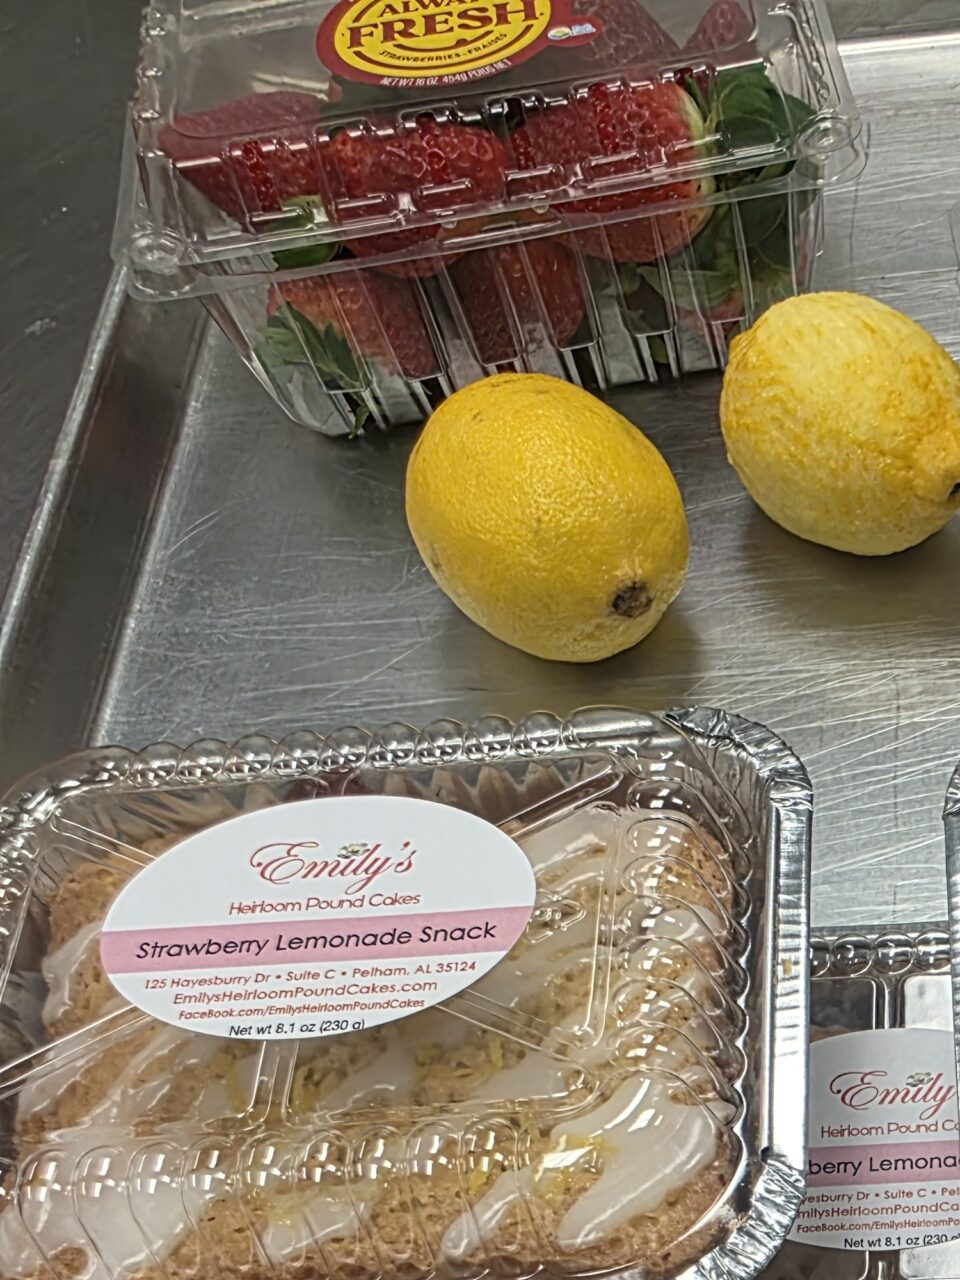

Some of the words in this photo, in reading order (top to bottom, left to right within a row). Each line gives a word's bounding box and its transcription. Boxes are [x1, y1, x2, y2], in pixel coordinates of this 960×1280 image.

[347, 0, 540, 50] FRESH
[379, 49, 462, 63] STRAWBERRIES
[467, 33, 508, 55] FRAISES
[249, 840, 420, 895] Emily's
[229, 900, 301, 915] Heirloom
[306, 895, 364, 911] Pound
[369, 892, 421, 907] Cakes
[136, 938, 269, 960] Strawberry
[276, 928, 412, 951] Lemonade
[419, 921, 497, 943] Snack
[144, 979, 167, 990] 125
[171, 975, 250, 989] Hayesburry
[255, 973, 271, 983] Dr
[286, 970, 320, 981] Suite
[324, 970, 336, 980] C
[352, 965, 410, 978] Pelham,
[414, 964, 431, 975] AL
[436, 961, 477, 974] 35124
[173, 980, 437, 1005] EmilysHeirloomPoundCakes.com
[179, 998, 424, 1021] FaceBook.com/EmilysHeirloomPoundCakes
[229, 1025, 252, 1036] Net
[256, 1024, 272, 1036] wt
[275, 1022, 295, 1034] 8.1
[300, 1023, 316, 1033] oz
[319, 1020, 349, 1034] (230
[830, 1070, 957, 1120] Emily
[821, 1123, 884, 1139] Heirloom
[888, 1120, 938, 1135] Pound
[808, 1159, 862, 1176] berry
[870, 1155, 960, 1172] Lemona
[857, 1191, 870, 1200] Dr
[884, 1189, 913, 1199] Suite
[917, 1188, 927, 1197] C
[844, 1238, 864, 1248] Net
[868, 1237, 881, 1247] wt
[885, 1236, 901, 1247] 8.1
[906, 1236, 920, 1245] oz
